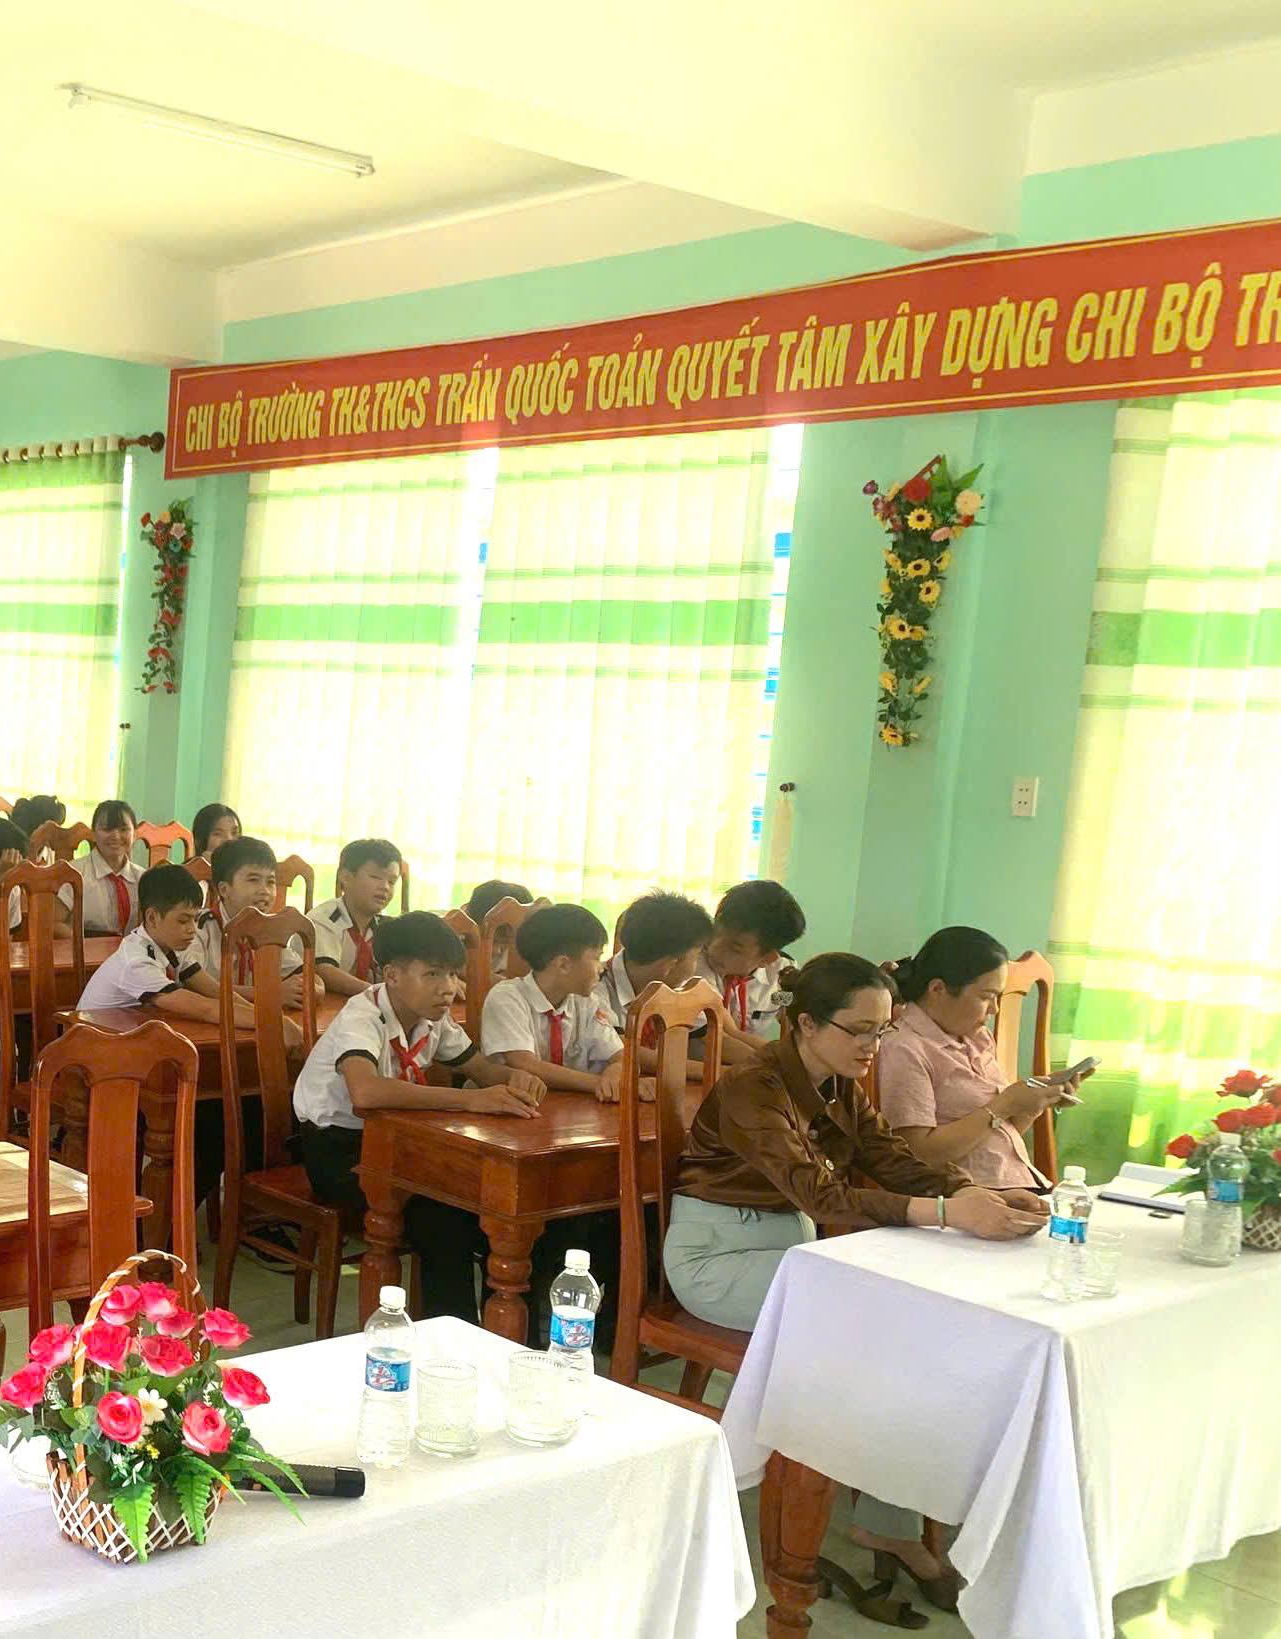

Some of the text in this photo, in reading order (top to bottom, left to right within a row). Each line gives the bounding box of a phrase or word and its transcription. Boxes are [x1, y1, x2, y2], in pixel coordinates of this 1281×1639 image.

[185, 404, 215, 453] CHI
[217, 390, 244, 458] BỘ
[246, 381, 326, 446] TRƯỜNG
[328, 375, 432, 438] TH&THCS
[434, 352, 503, 427] TRẦN
[504, 342, 579, 426] QUỐC
[584, 332, 664, 412] TOẢN
[666, 315, 771, 411] QUYẾT
[775, 314, 854, 393] TÂM
[855, 301, 938, 385] XÂY
[939, 296, 1059, 390] DỰNG
[1065, 287, 1149, 365] CHI
[1151, 261, 1223, 369] BỘ
